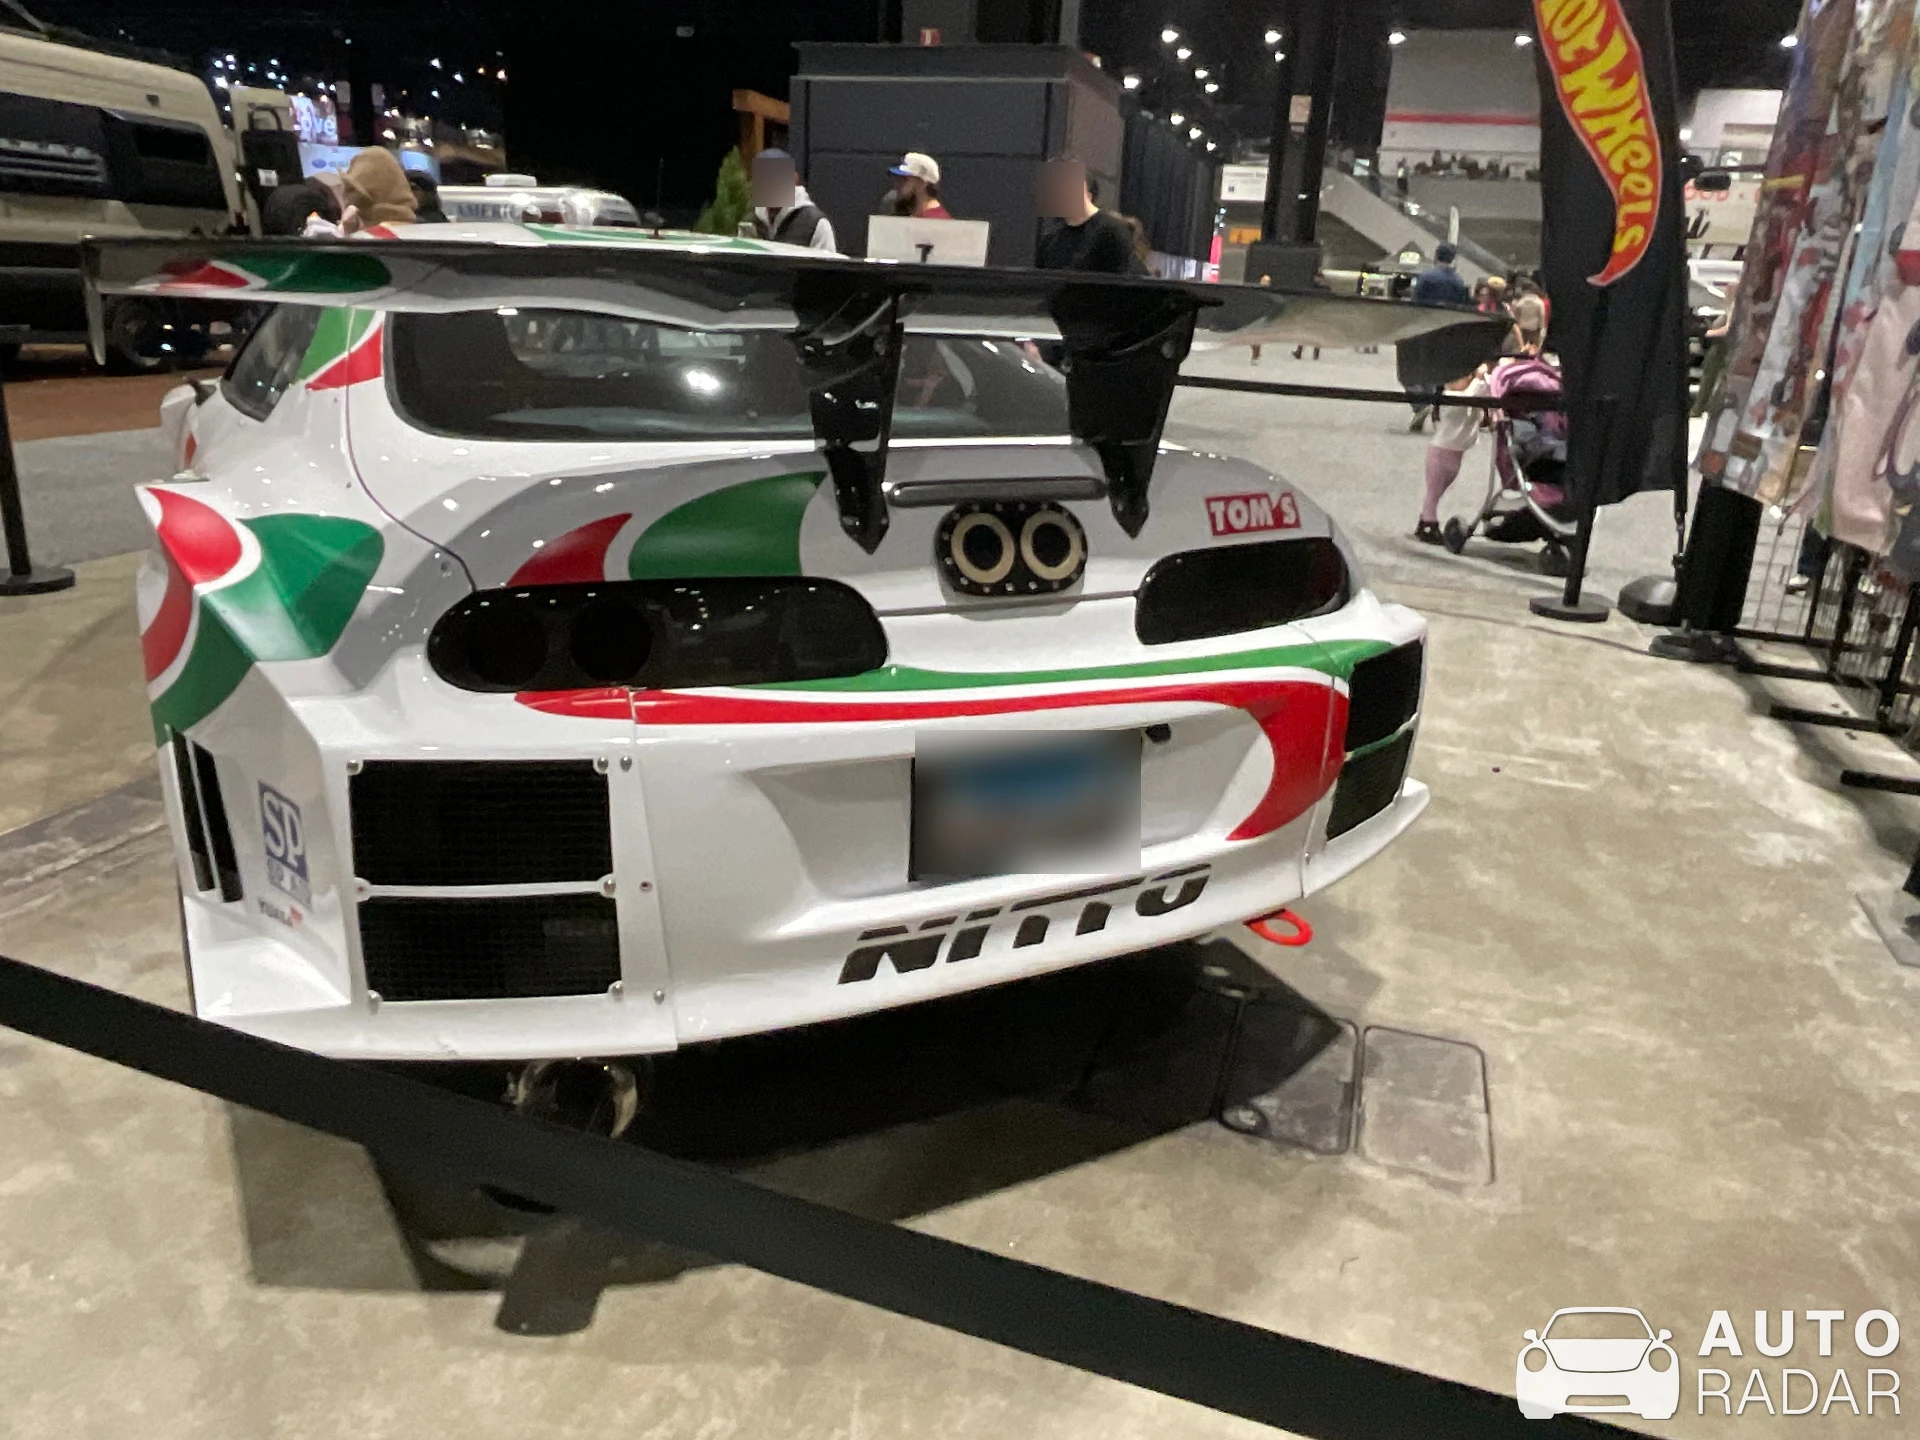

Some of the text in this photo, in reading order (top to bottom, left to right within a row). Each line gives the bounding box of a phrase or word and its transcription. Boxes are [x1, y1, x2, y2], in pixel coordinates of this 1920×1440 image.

[1210, 495, 1297, 531] TOM'S
[263, 790, 304, 867] SP
[837, 863, 1211, 985] NITTO
